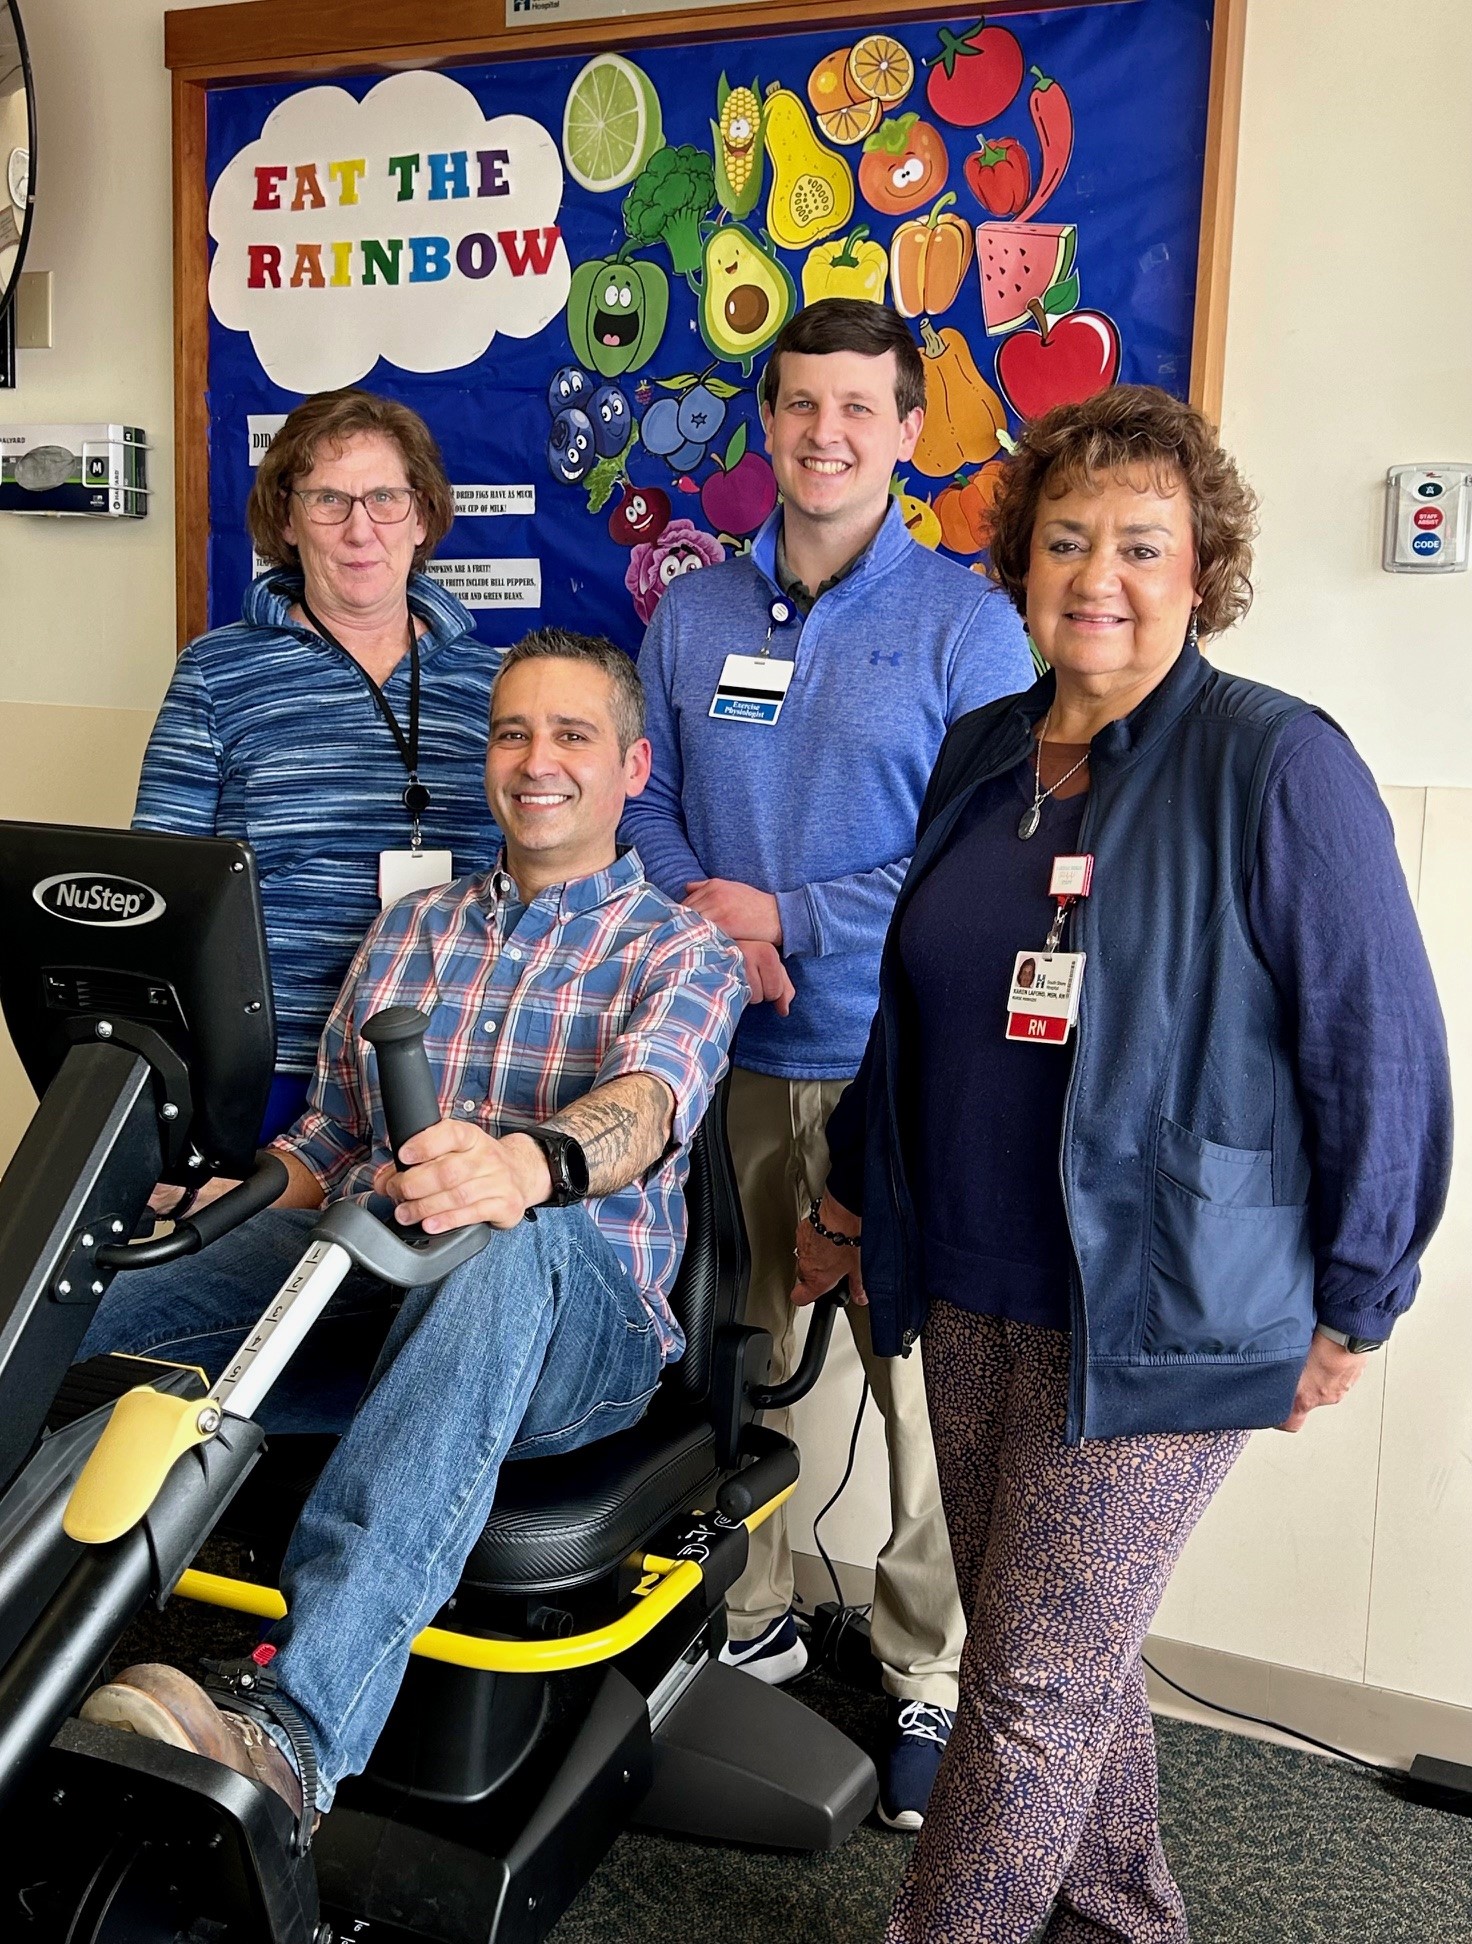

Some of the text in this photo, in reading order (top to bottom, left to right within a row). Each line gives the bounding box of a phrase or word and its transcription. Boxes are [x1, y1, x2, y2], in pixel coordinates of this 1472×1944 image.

[252, 149, 510, 211] EAT THE
[247, 226, 561, 288] RAINBOW
[253, 433, 271, 448] DID
[456, 490, 475, 499] DRIED
[475, 490, 489, 499] FIGS
[490, 490, 507, 498] HAVE
[508, 490, 515, 498] AS
[516, 490, 533, 498] MUCH
[468, 504, 479, 512] CUP
[480, 504, 488, 512] OF
[490, 504, 507, 512] MILK!
[1413, 540, 1440, 549] CODE
[427, 564, 491, 573] UMPKINS ARE A FRUIT!
[445, 578, 465, 587] FRUITS
[466, 578, 489, 586] INCLUDE
[490, 578, 505, 586] BELL
[470, 592, 482, 600] AND
[483, 592, 503, 600] GREEN
[504, 591, 524, 600] BEANS.
[732, 701, 760, 711] Exercise
[724, 706, 765, 718] Physiologist
[56, 883, 141, 917] NuStep
[1027, 1018, 1047, 1037] RN
